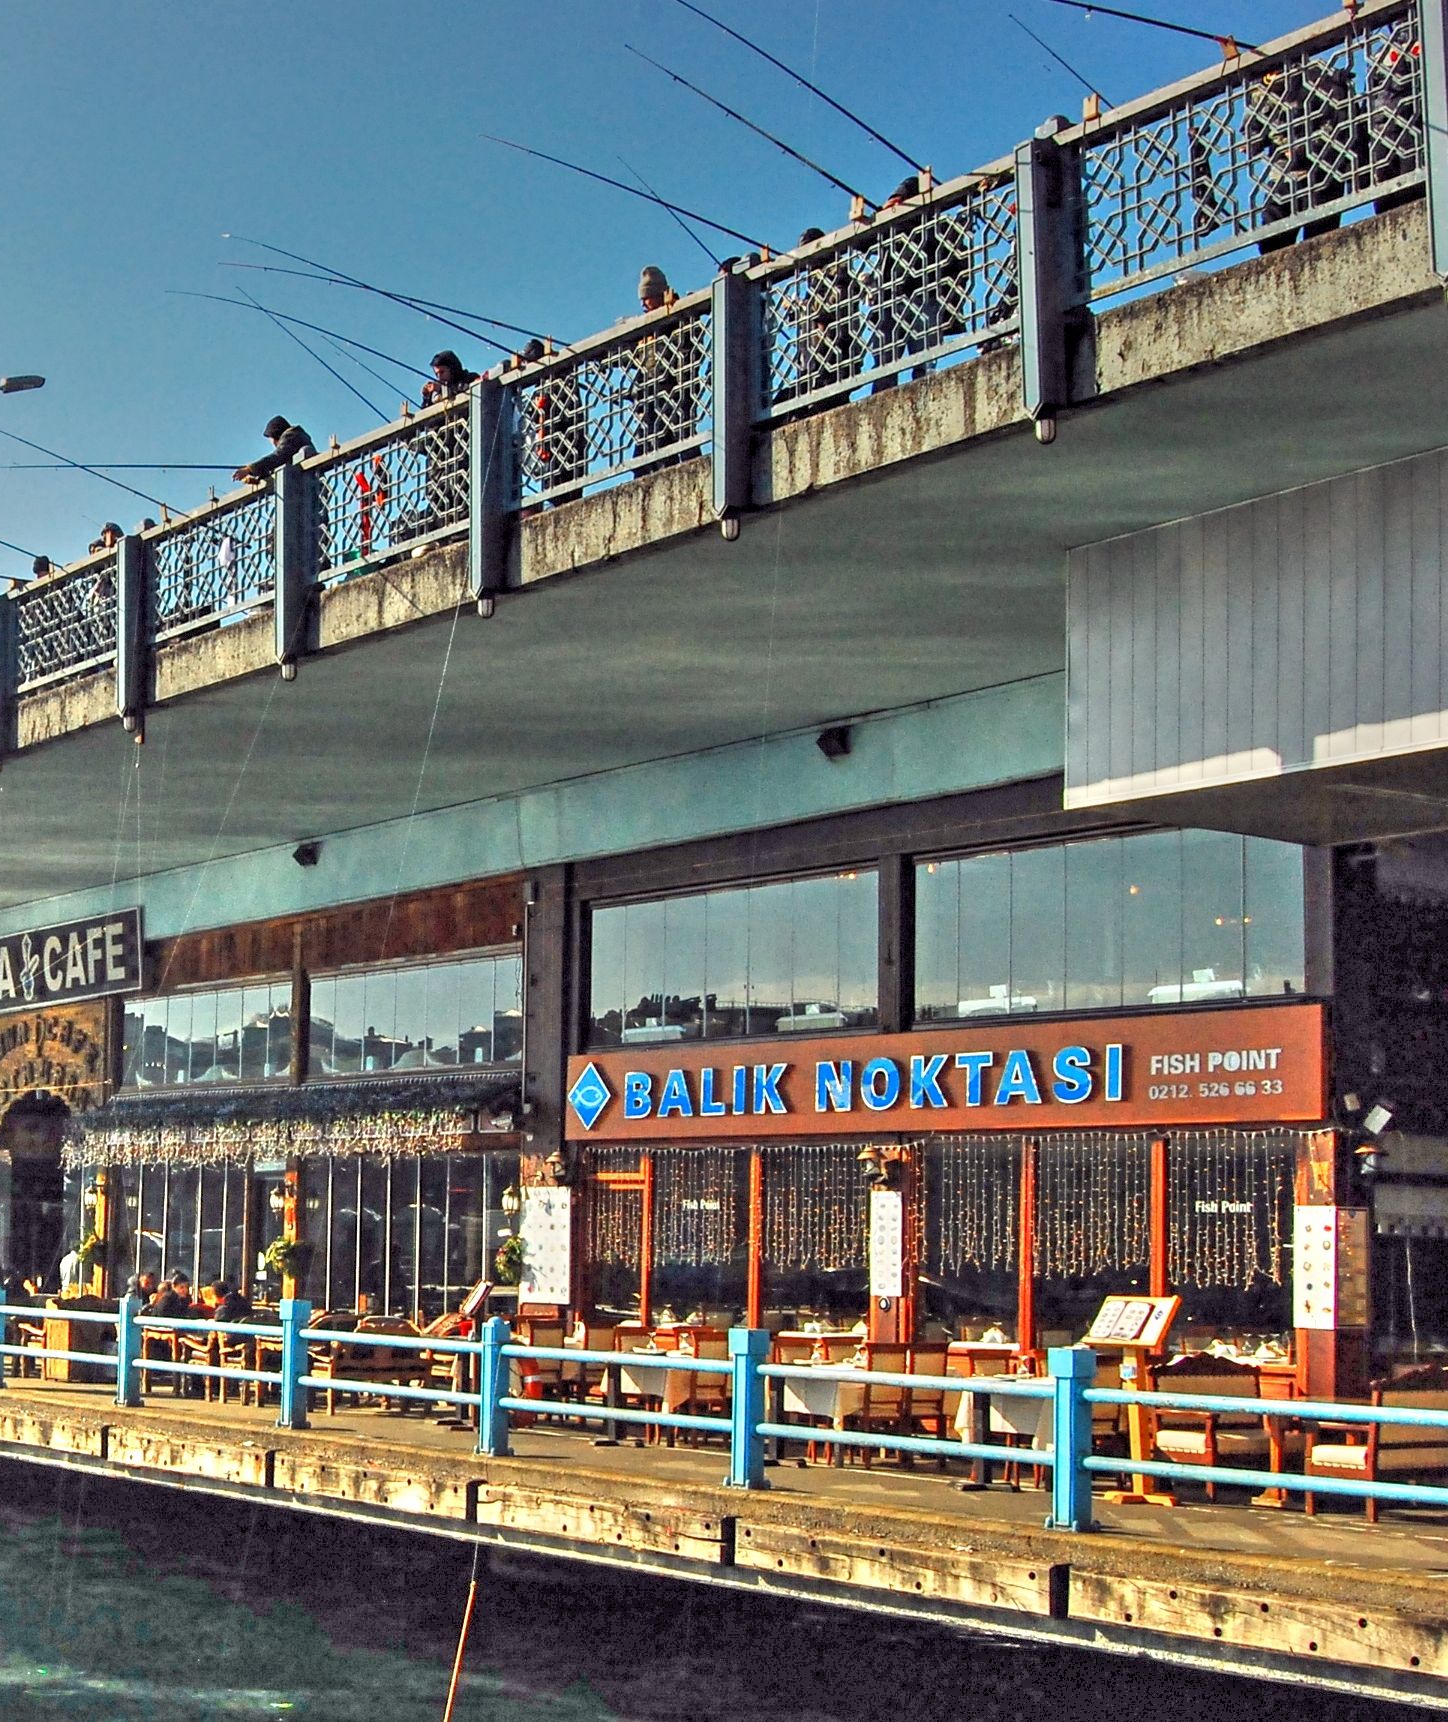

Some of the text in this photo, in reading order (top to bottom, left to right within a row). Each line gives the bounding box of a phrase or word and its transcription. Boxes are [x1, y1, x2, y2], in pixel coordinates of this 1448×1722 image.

[43, 922, 126, 992] CAFE
[1150, 1048, 1282, 1075] FISH POINT
[624, 1044, 1123, 1119] BALIK NOKTASI
[1148, 1079, 1283, 1100] 0212. 526 66 33
[1195, 1200, 1252, 1214] Fish Point
